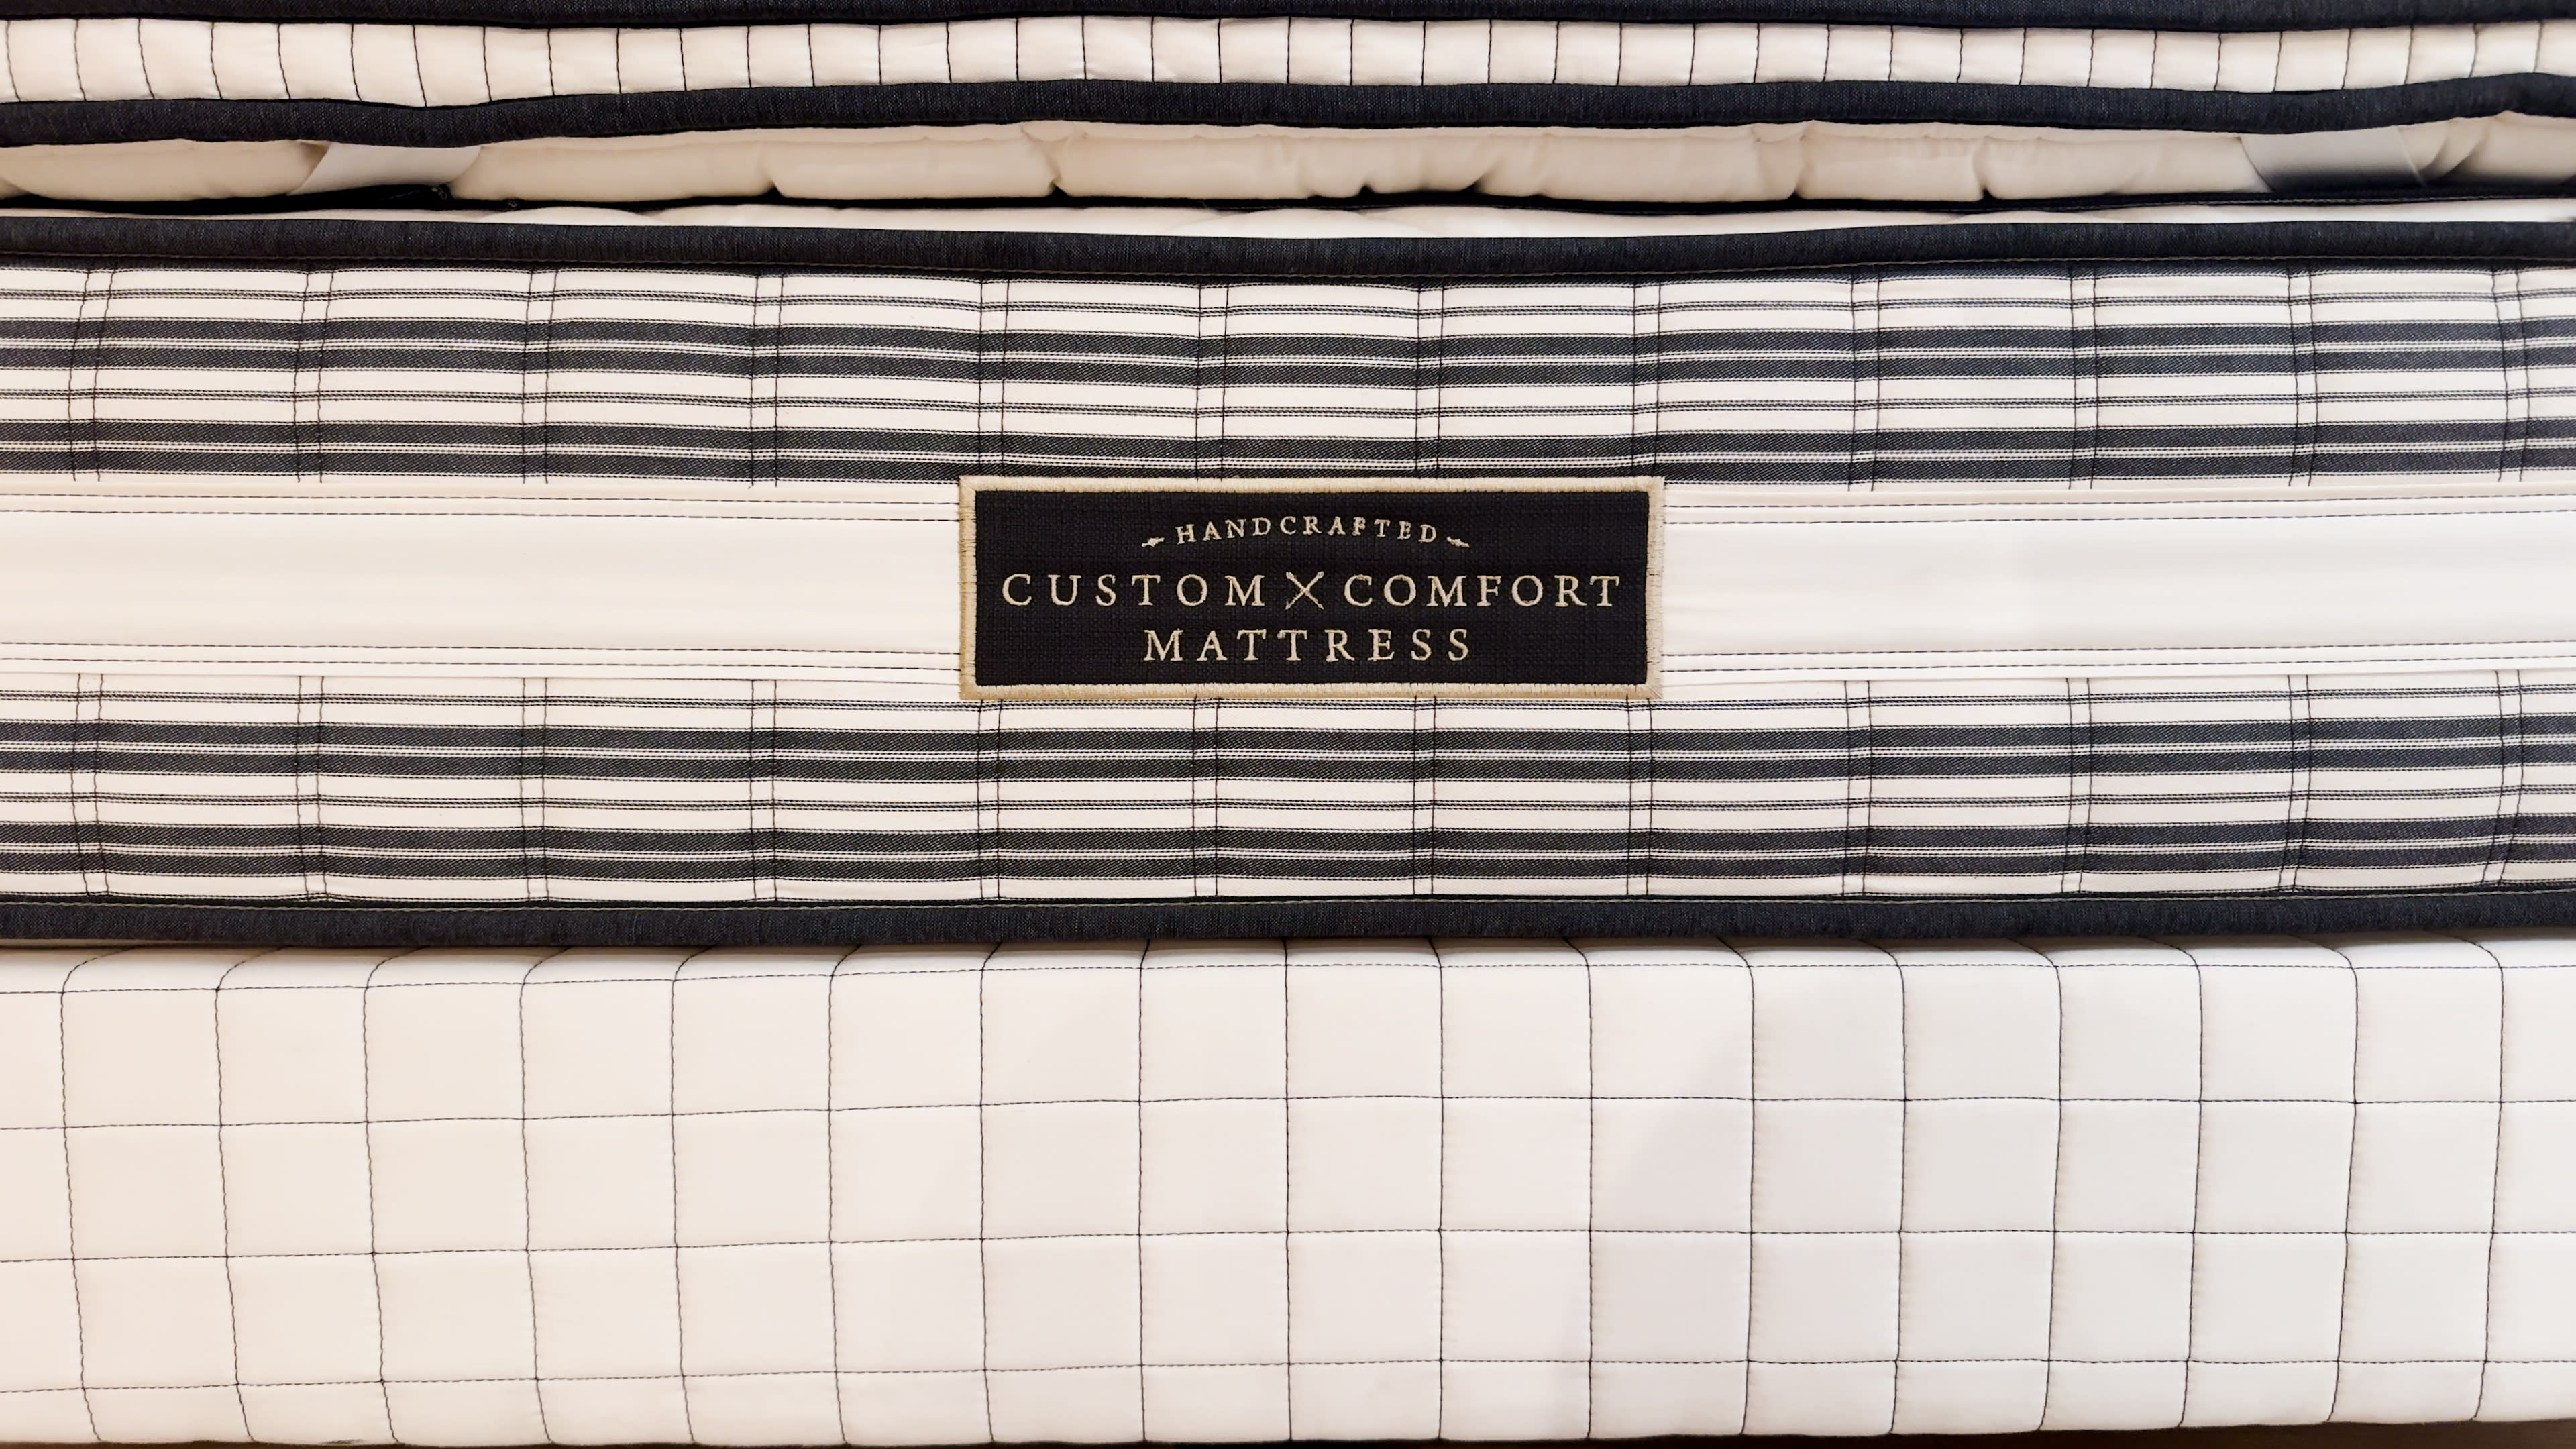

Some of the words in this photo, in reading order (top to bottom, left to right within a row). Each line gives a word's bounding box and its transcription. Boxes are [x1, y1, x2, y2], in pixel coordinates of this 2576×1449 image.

[1175, 515, 1437, 543] HANDCRAFTED
[1002, 573, 1265, 607] CUSTOM
[1344, 573, 1621, 608] COMFORT
[1143, 628, 1470, 663] MATTRESS
